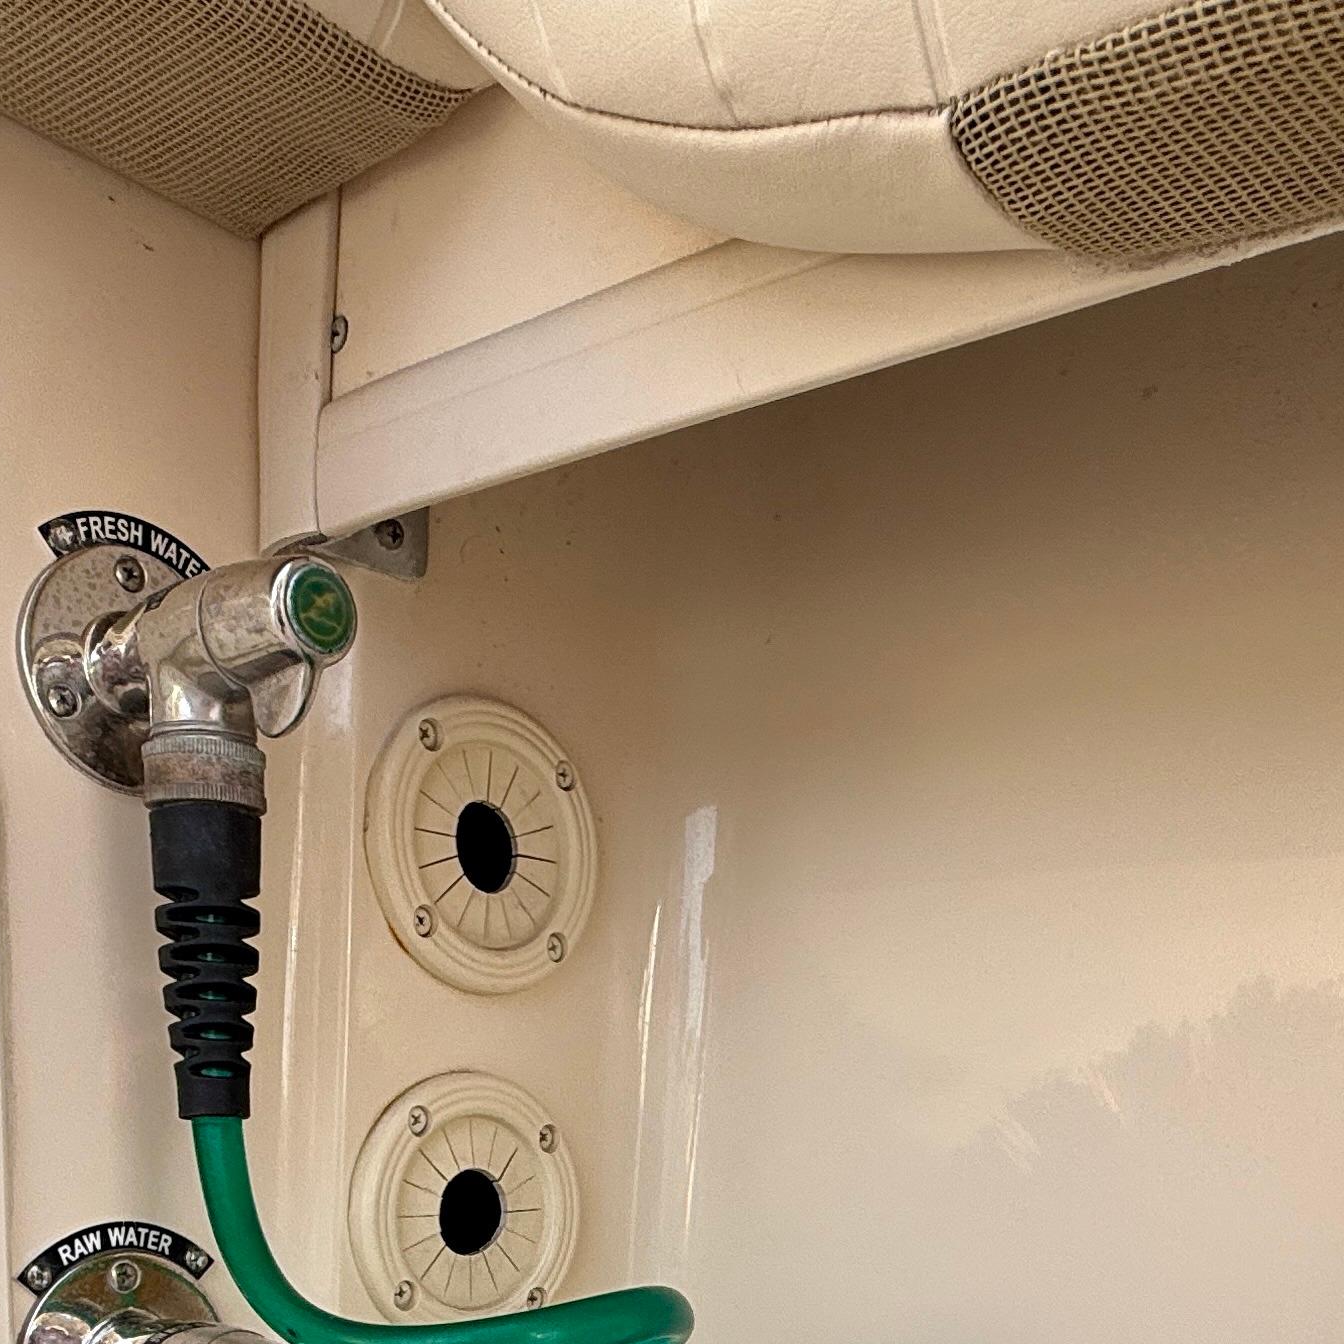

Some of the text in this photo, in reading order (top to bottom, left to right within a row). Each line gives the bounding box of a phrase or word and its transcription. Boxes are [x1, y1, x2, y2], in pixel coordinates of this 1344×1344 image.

[76, 516, 207, 578] FRESH WATE
[57, 1226, 173, 1266] RAW WATER
